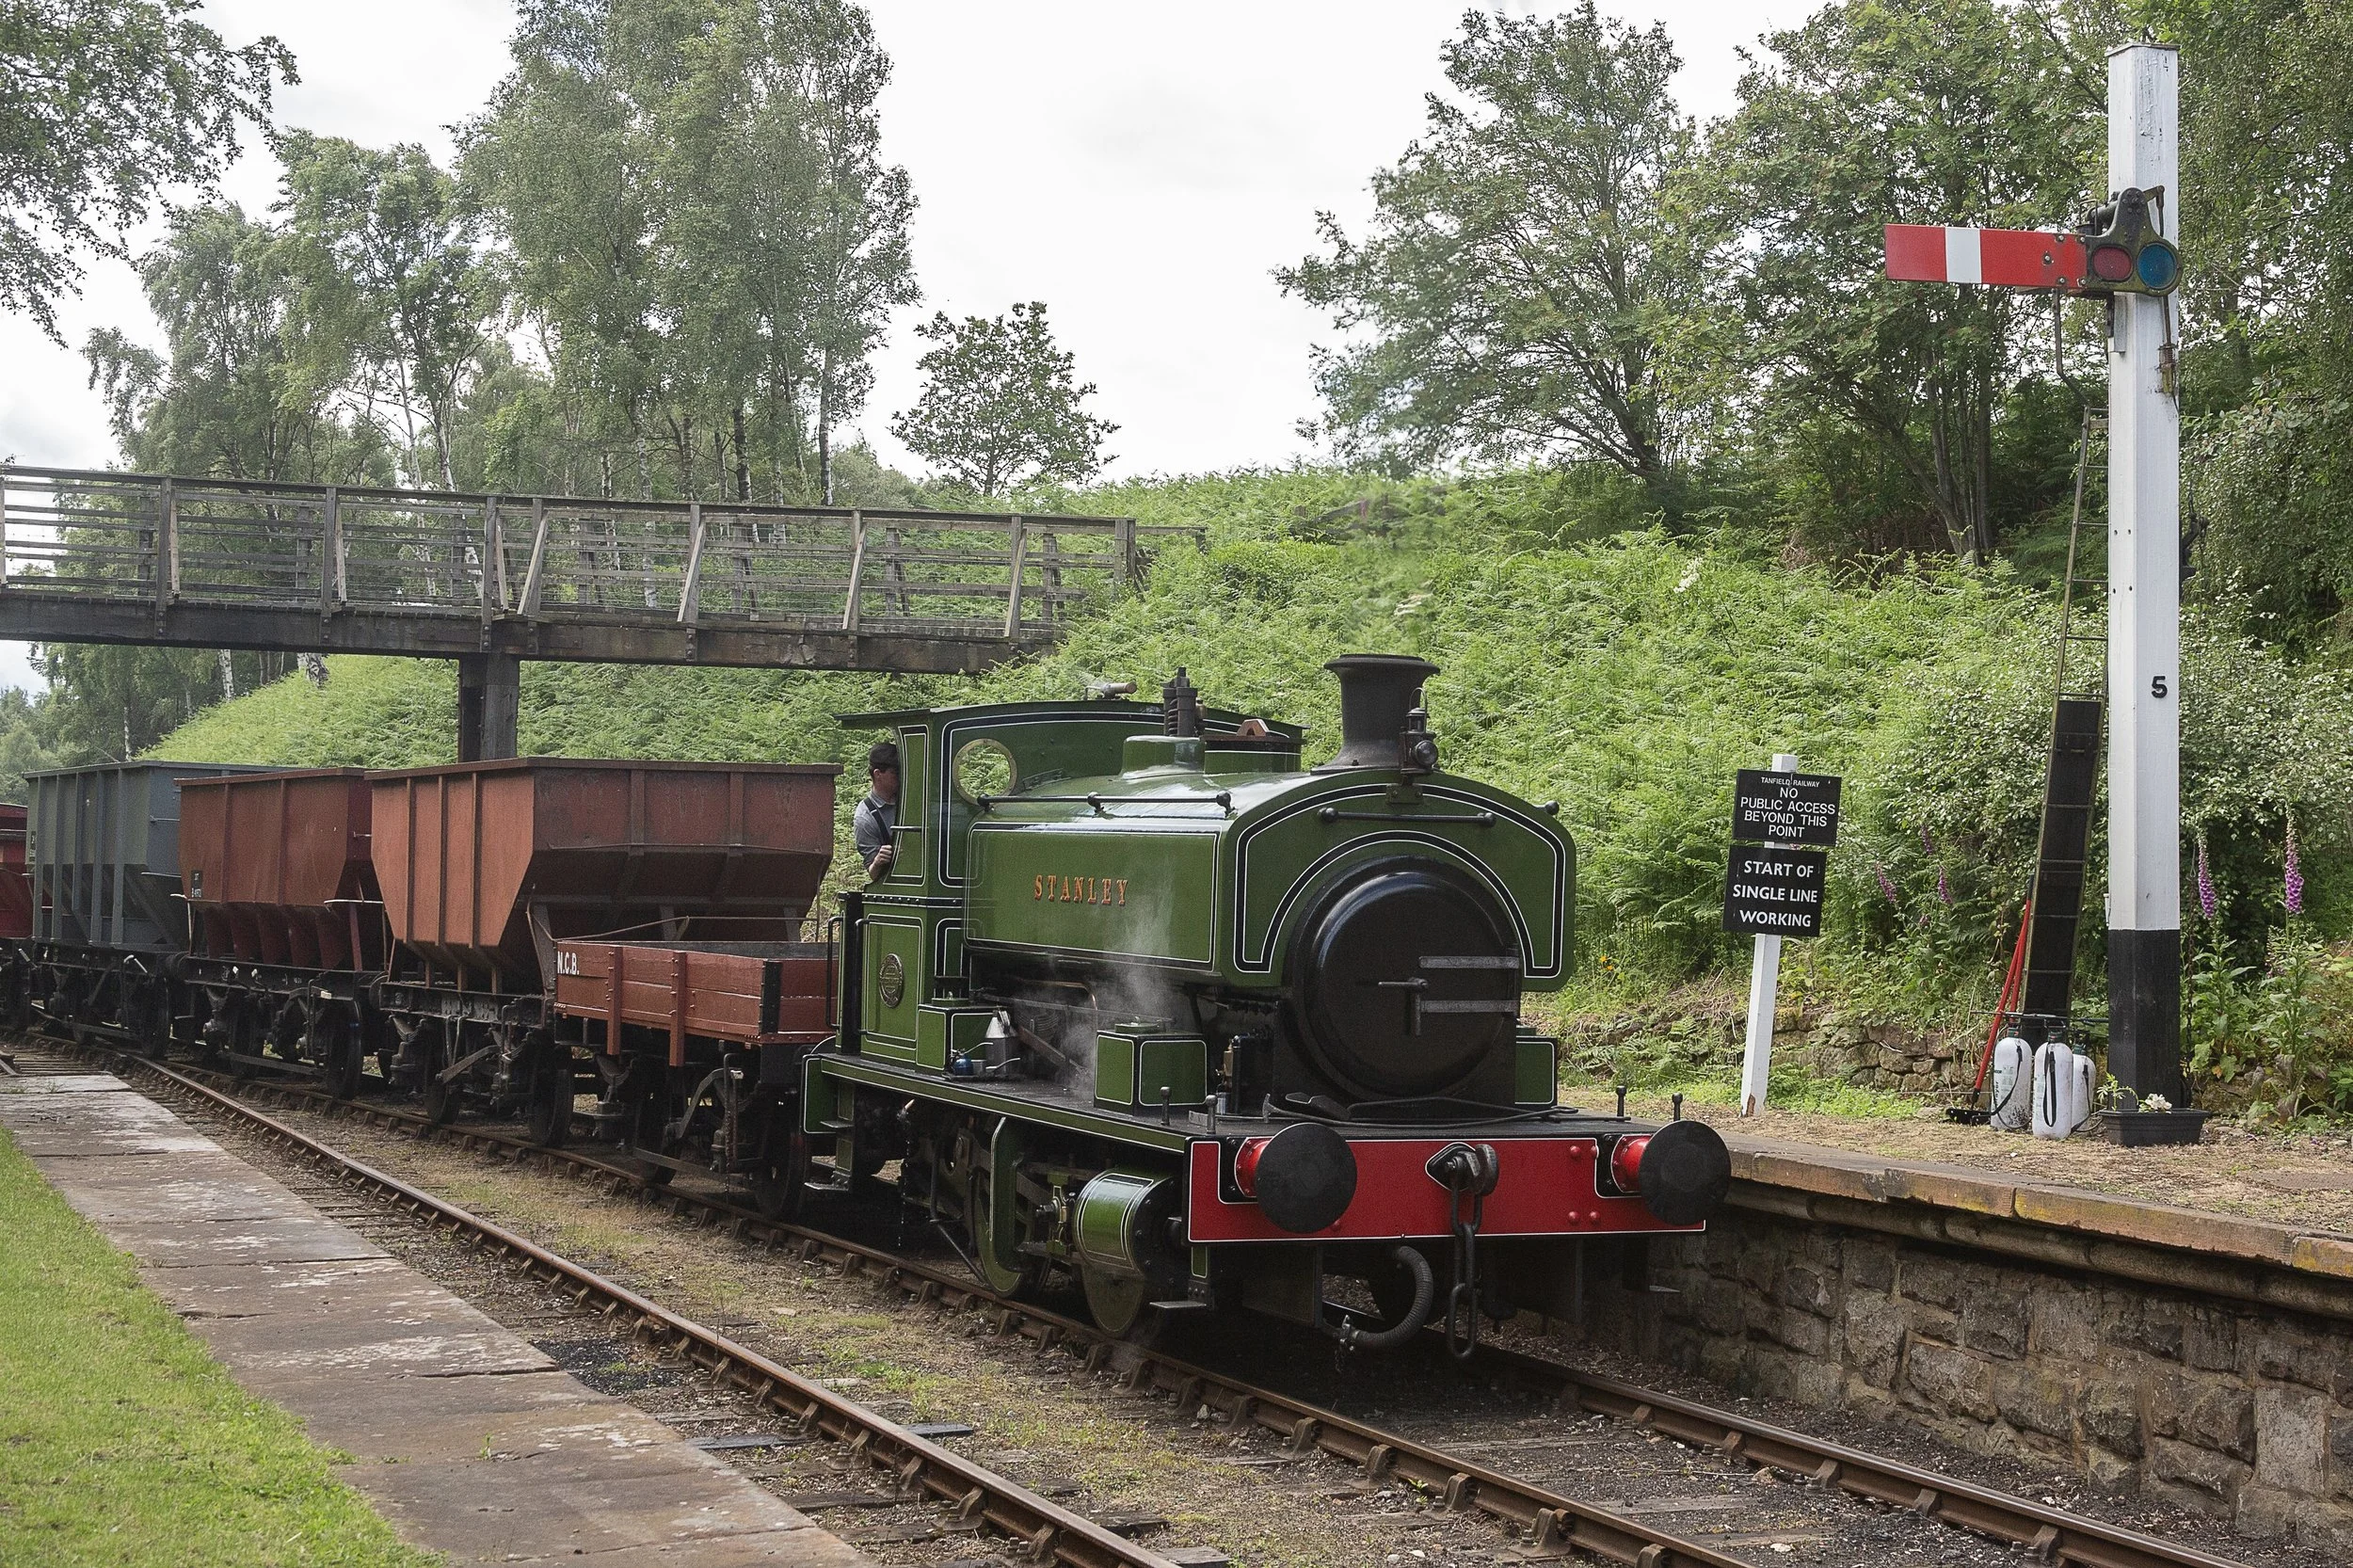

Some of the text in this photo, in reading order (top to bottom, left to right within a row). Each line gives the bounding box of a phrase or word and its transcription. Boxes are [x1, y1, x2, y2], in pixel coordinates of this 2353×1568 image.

[2151, 675, 2169, 698] 5
[1761, 776, 1820, 788] TANFIELD RAILWAY
[1779, 787, 1799, 799] NO
[1740, 797, 1835, 815] PUBLIC ACCESS
[1744, 810, 1828, 827] BEYOND THIS
[1768, 824, 1805, 838] POINT
[1743, 860, 1814, 878] START OF
[1034, 874, 1128, 905] STANLEY
[1733, 884, 1817, 904] SINGLE LINE
[1739, 909, 1812, 927] WORKING
[557, 951, 580, 975] N.C.B.
